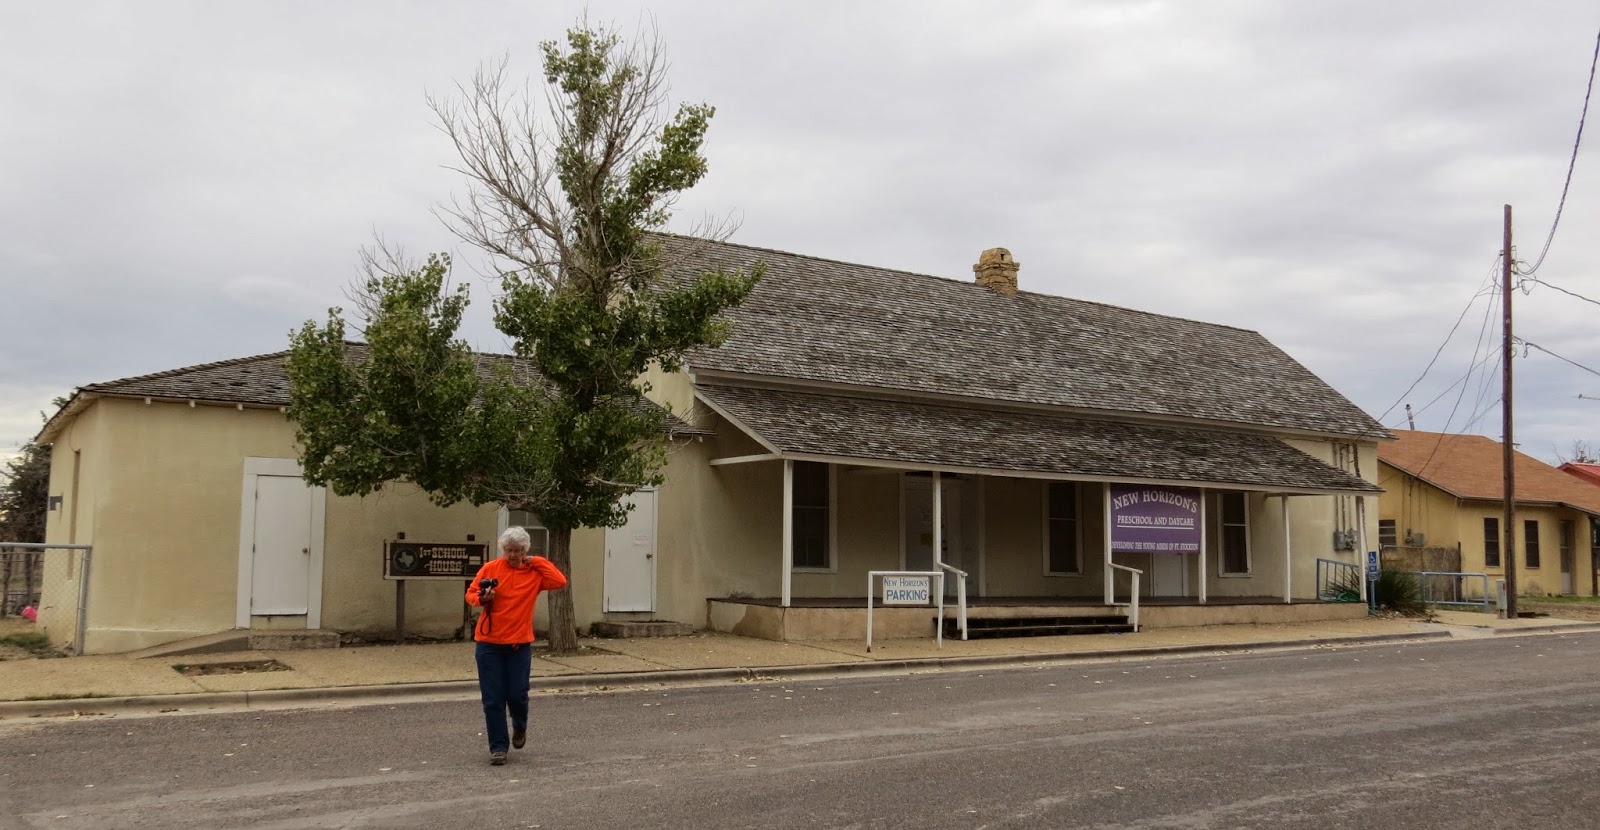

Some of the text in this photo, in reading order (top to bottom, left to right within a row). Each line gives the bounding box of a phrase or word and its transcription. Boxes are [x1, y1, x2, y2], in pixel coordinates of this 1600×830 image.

[1113, 490, 1198, 513] NEW HORIZON'S
[1117, 515, 1194, 526] PRESCHOOL AND DAYCARE
[432, 547, 468, 559] SCHOOL
[428, 560, 462, 572] HOUSE
[884, 577, 897, 586] NEW
[886, 590, 927, 600] PARKING
